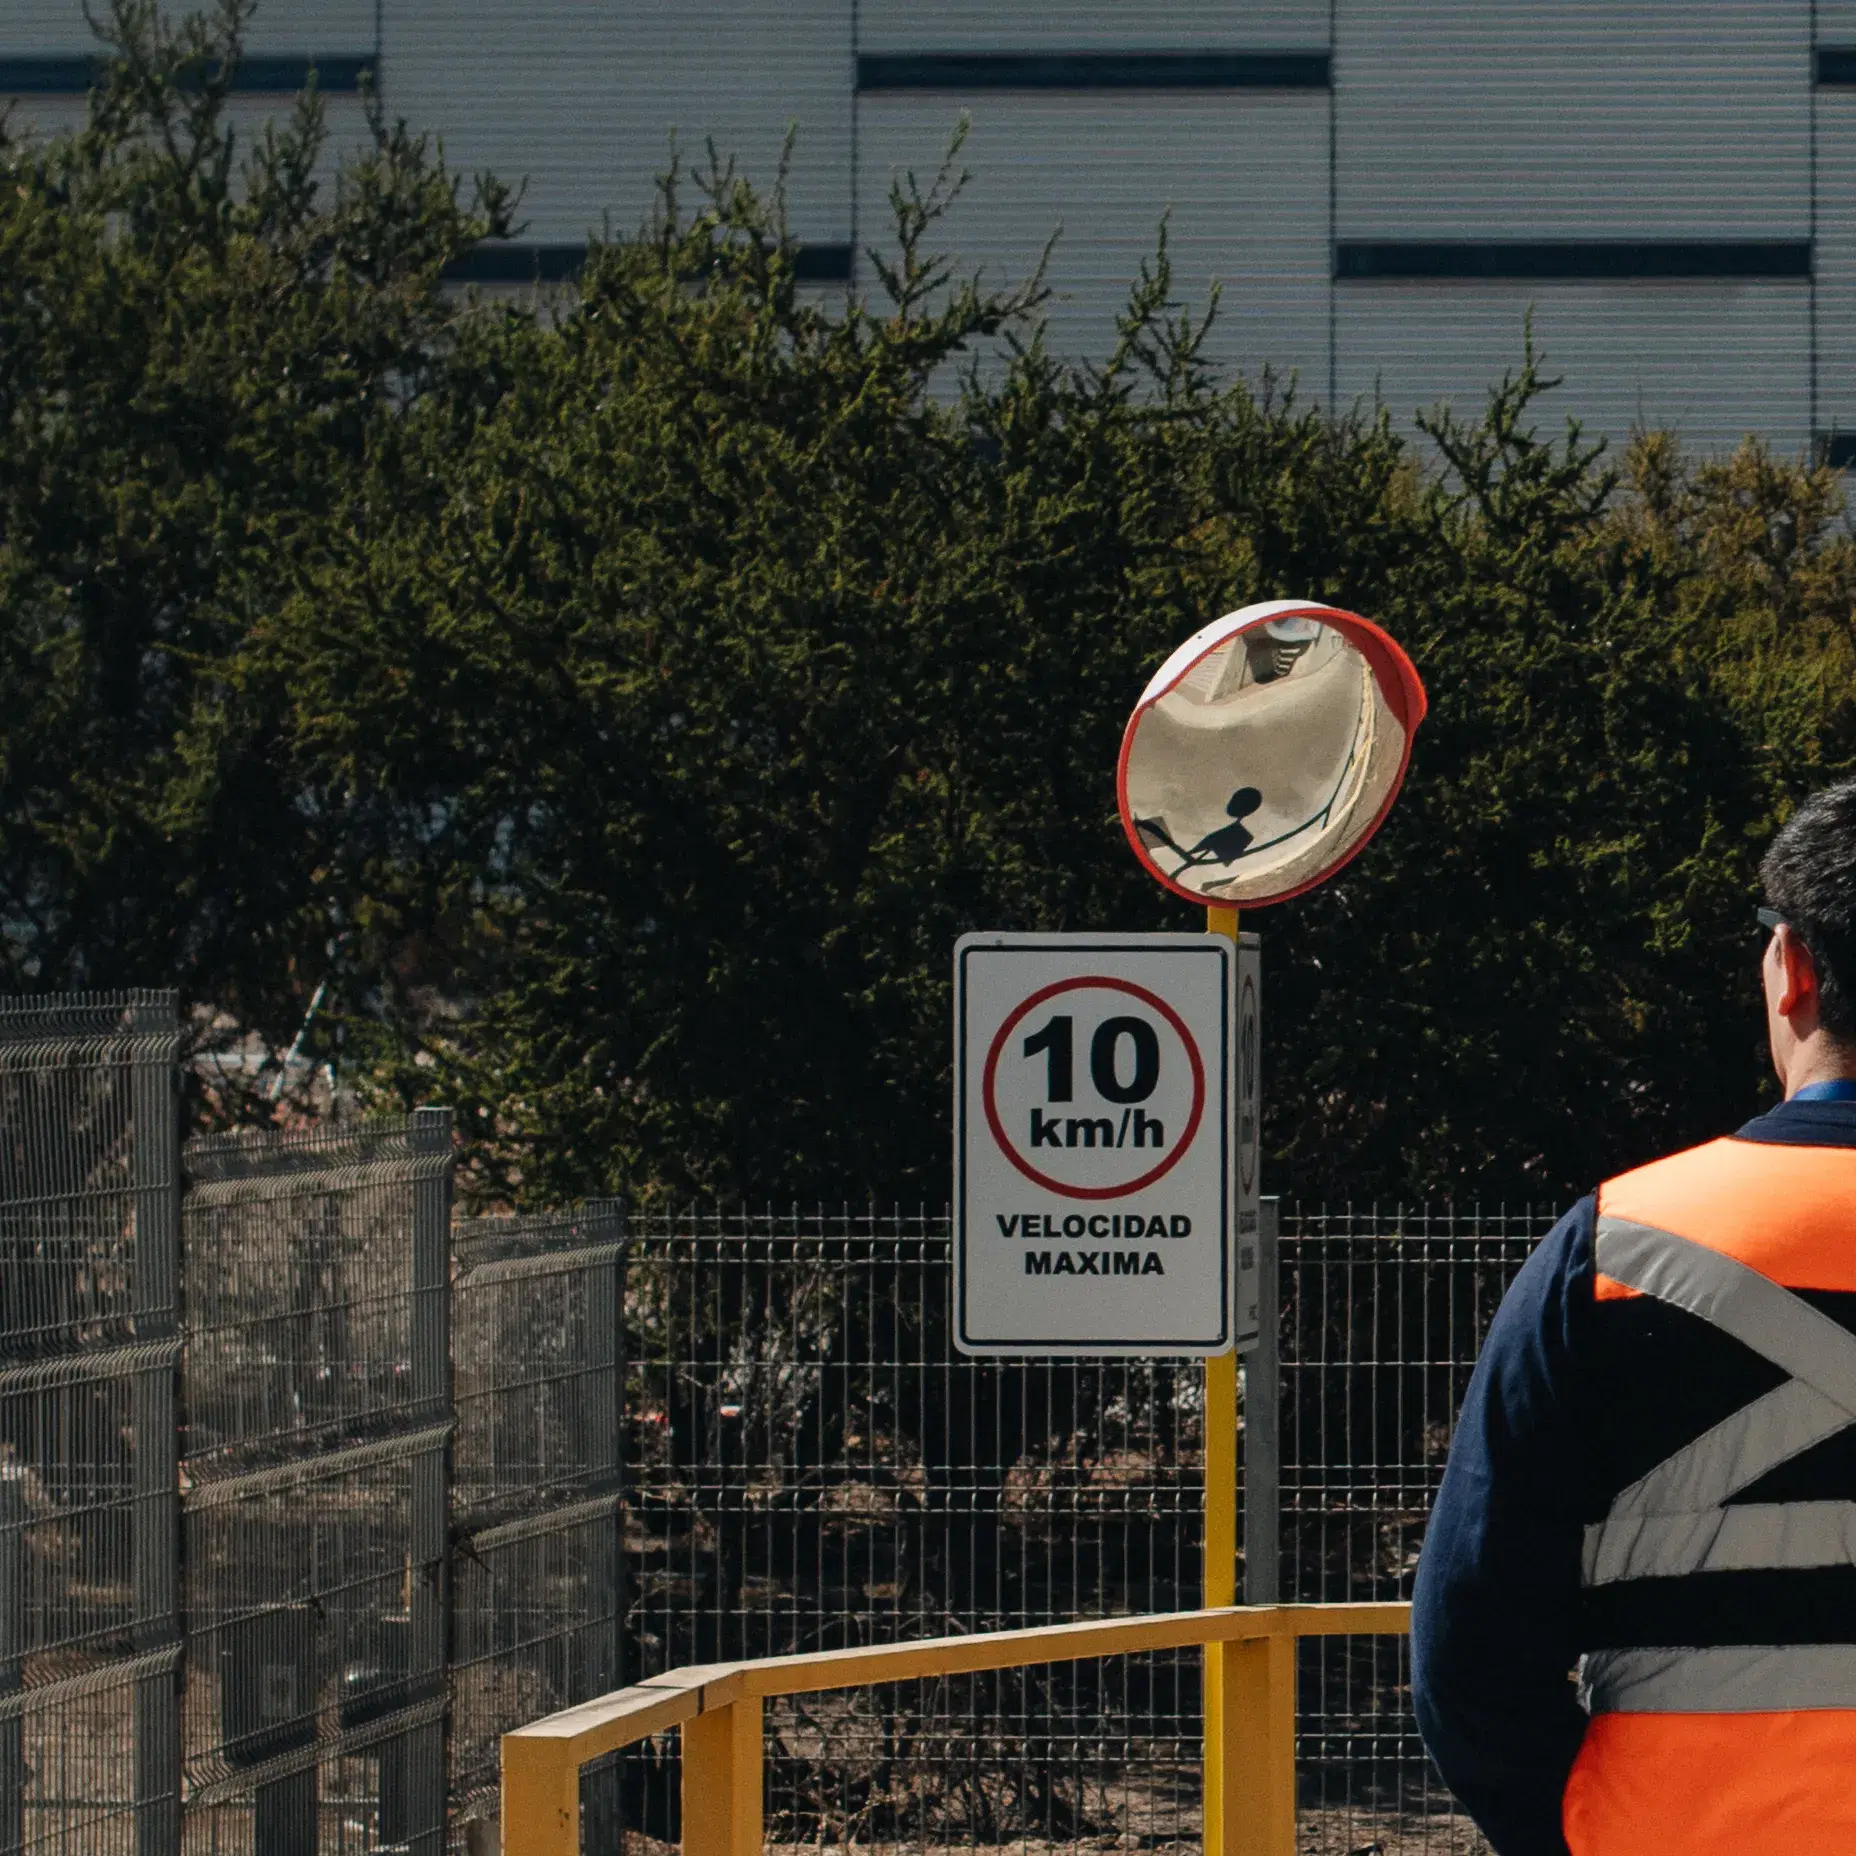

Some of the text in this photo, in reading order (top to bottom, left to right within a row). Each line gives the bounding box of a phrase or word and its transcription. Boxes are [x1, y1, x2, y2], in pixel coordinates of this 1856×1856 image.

[1023, 1015, 1161, 1105] 10
[1030, 1107, 1165, 1149] km/h
[995, 1214, 1193, 1239] VELOCIDAD
[1025, 1251, 1166, 1276] MAXIMA
